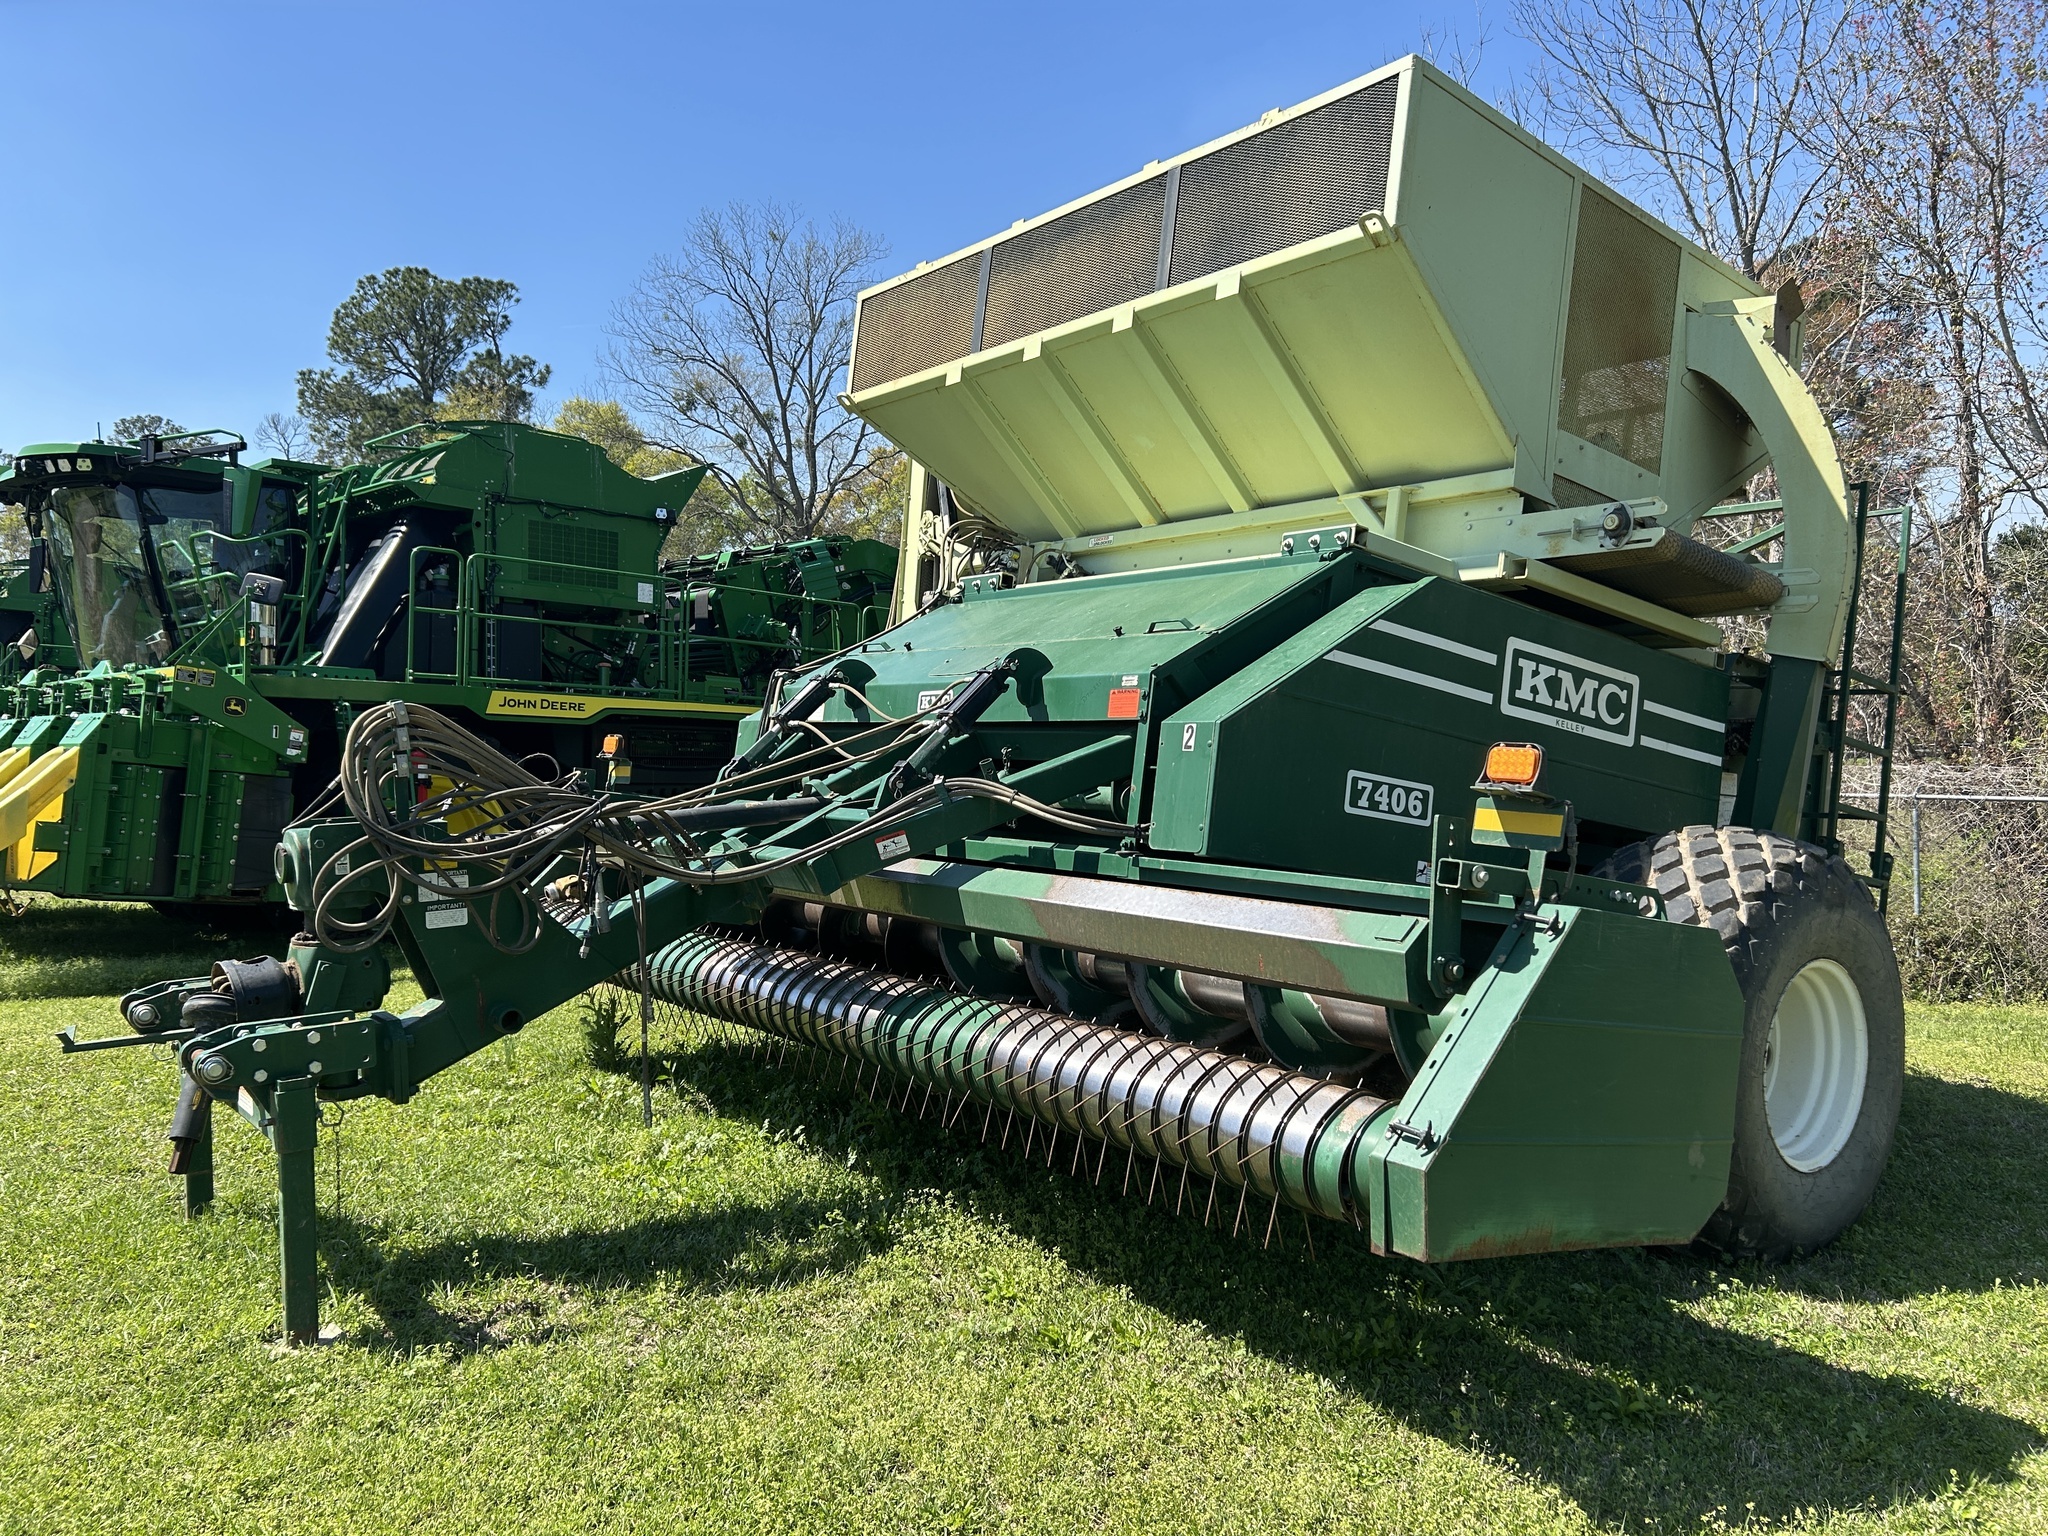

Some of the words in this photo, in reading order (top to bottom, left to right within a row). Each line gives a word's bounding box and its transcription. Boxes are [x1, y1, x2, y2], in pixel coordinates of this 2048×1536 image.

[1515, 658, 1628, 725] KMC
[499, 696, 537, 709] JOHN
[541, 699, 586, 712] DEERE
[1555, 719, 1586, 733] KELLEY
[1183, 725, 1195, 749] 2
[1357, 780, 1424, 817] 7406
[427, 902, 465, 911] IMPORTANT!
